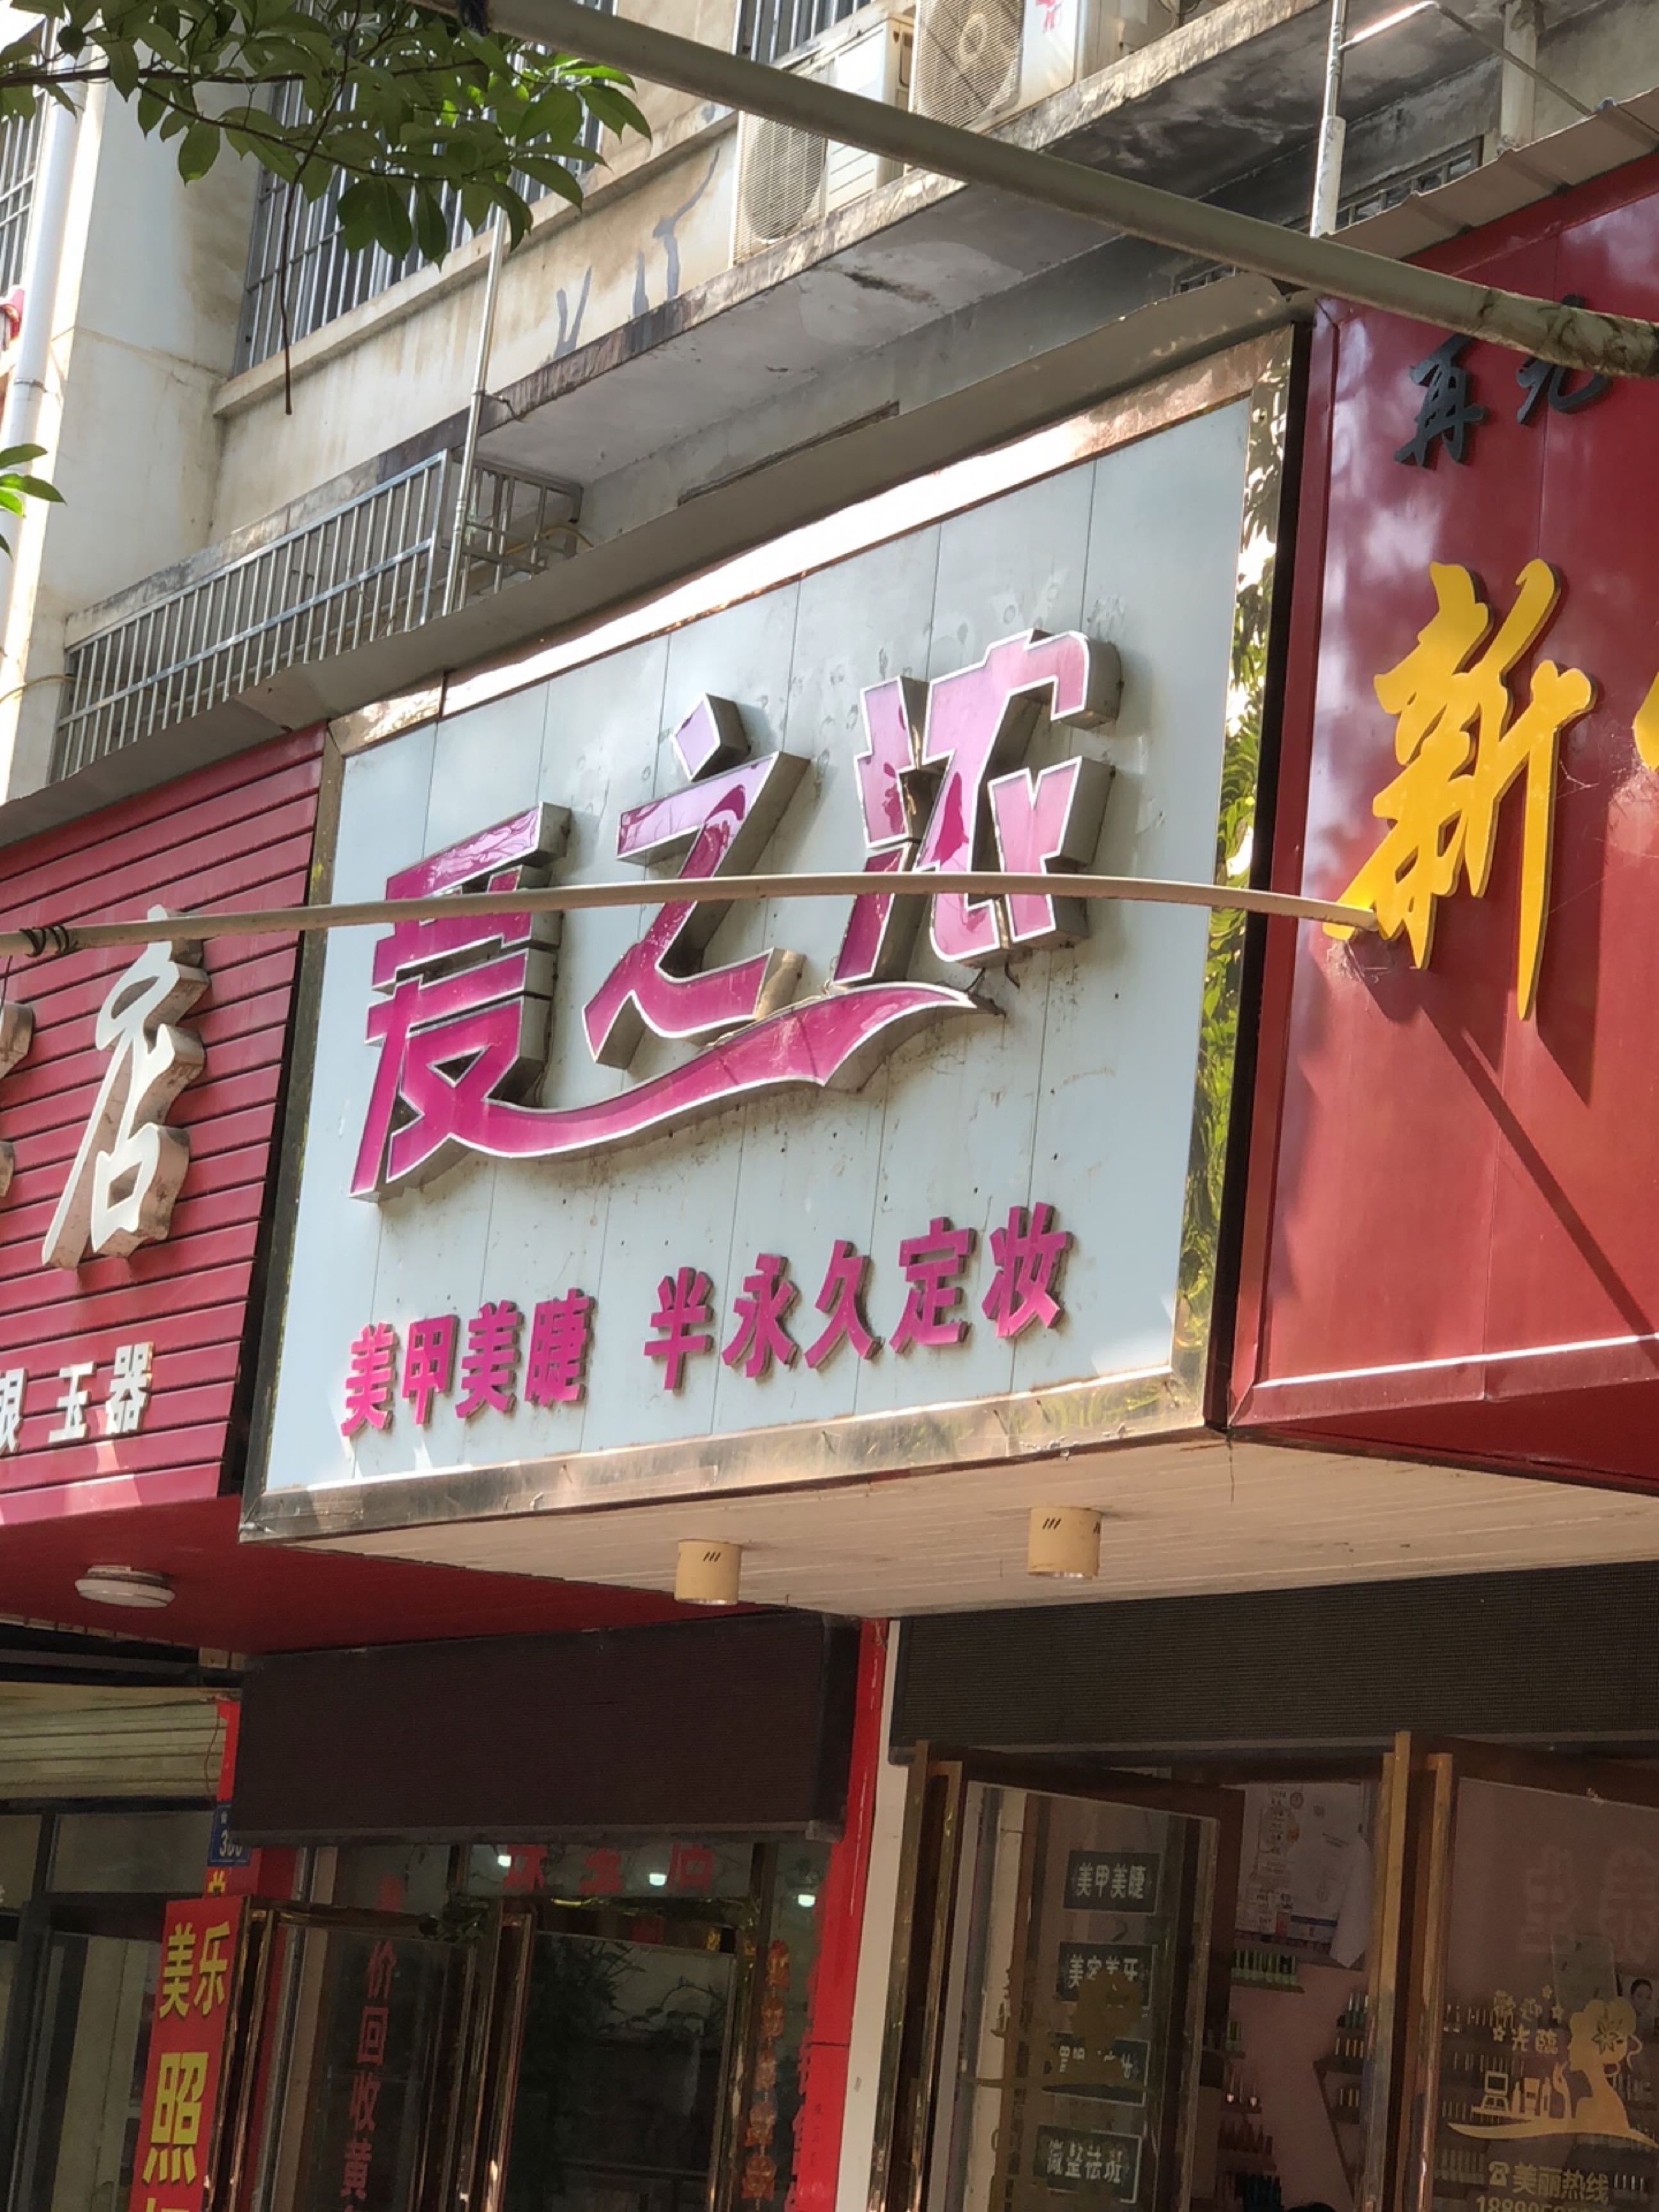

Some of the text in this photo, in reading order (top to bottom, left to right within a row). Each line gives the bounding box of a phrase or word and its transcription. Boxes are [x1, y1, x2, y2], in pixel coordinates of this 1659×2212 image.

[1323, 557, 1659, 1022] 新
[0, 904, 182, 1266] 店
[341, 1202, 1071, 1437] 美甲美睫 半永久定妆
[142, 2051, 209, 2212] 照
